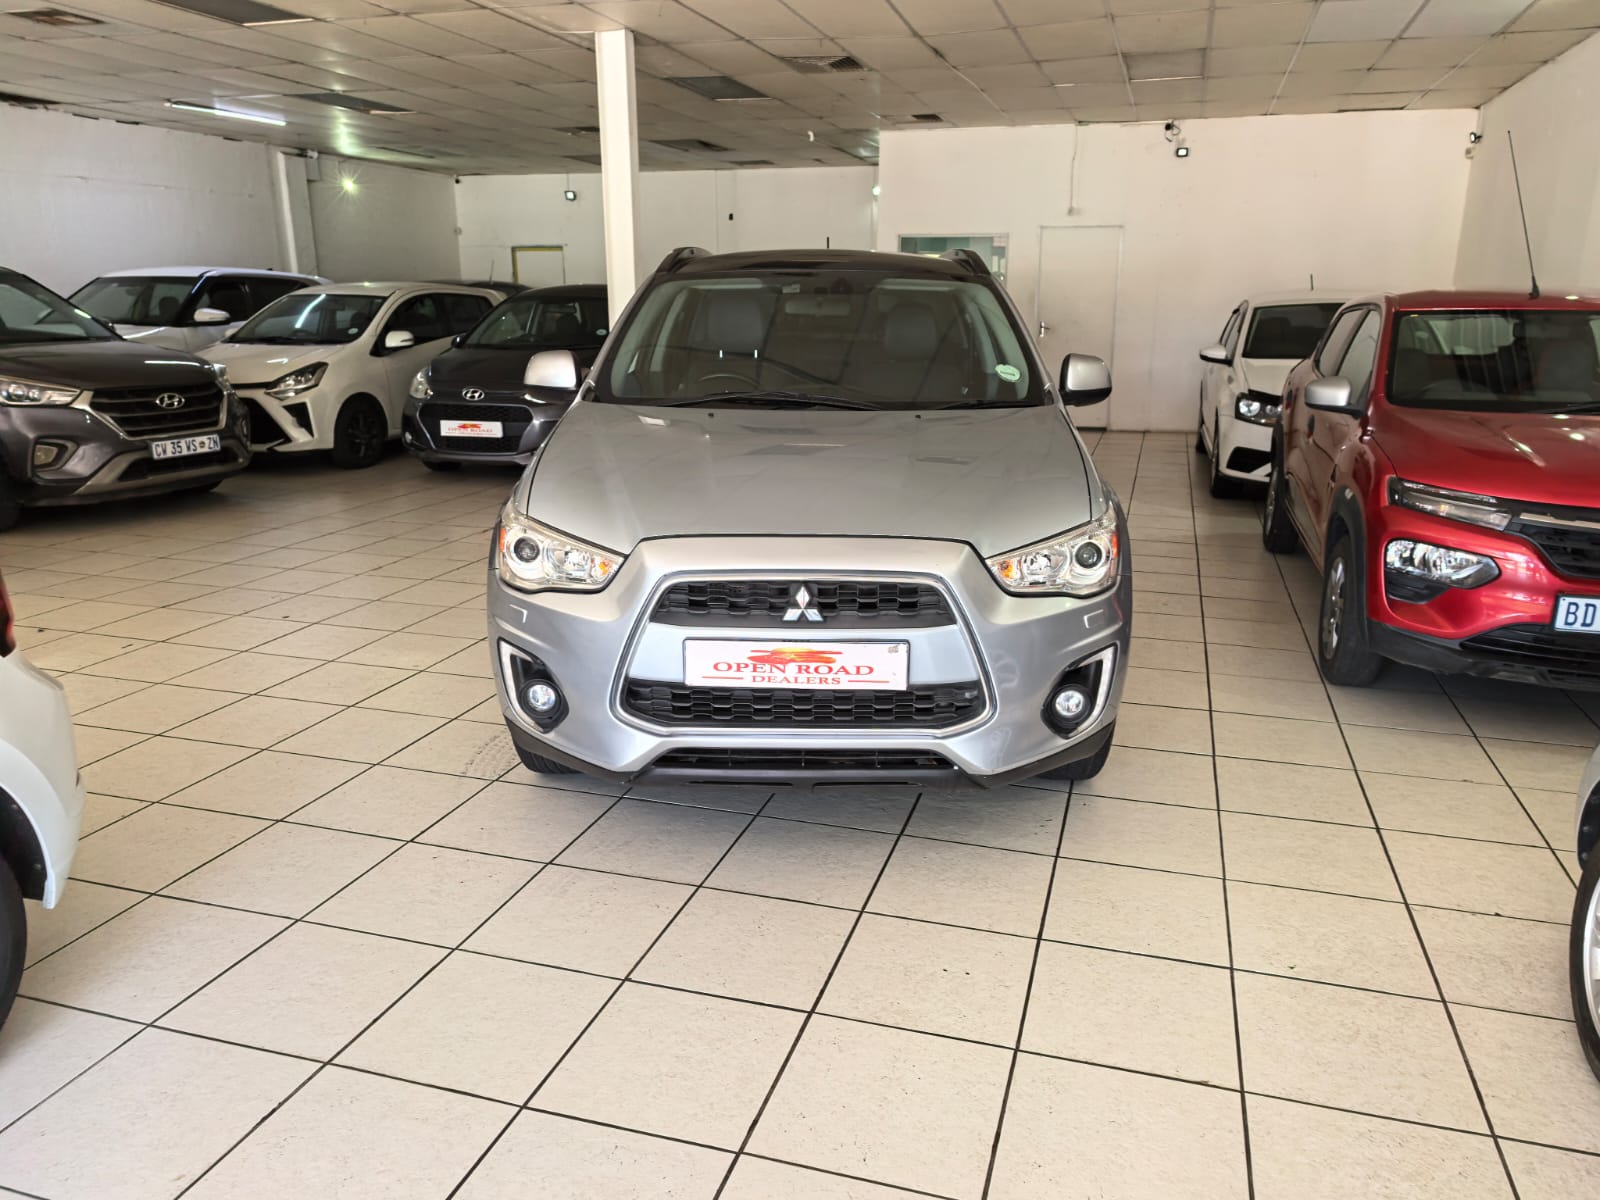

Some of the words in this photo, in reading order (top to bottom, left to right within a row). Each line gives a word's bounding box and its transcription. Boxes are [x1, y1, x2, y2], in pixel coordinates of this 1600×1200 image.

[170, 441, 183, 455] 35
[185, 439, 197, 452] VS
[207, 436, 219, 450] ZN
[1564, 602, 1597, 627] BD
[713, 662, 786, 674] OPEN
[796, 664, 874, 676] ROAD
[751, 676, 841, 685] DEALERS
